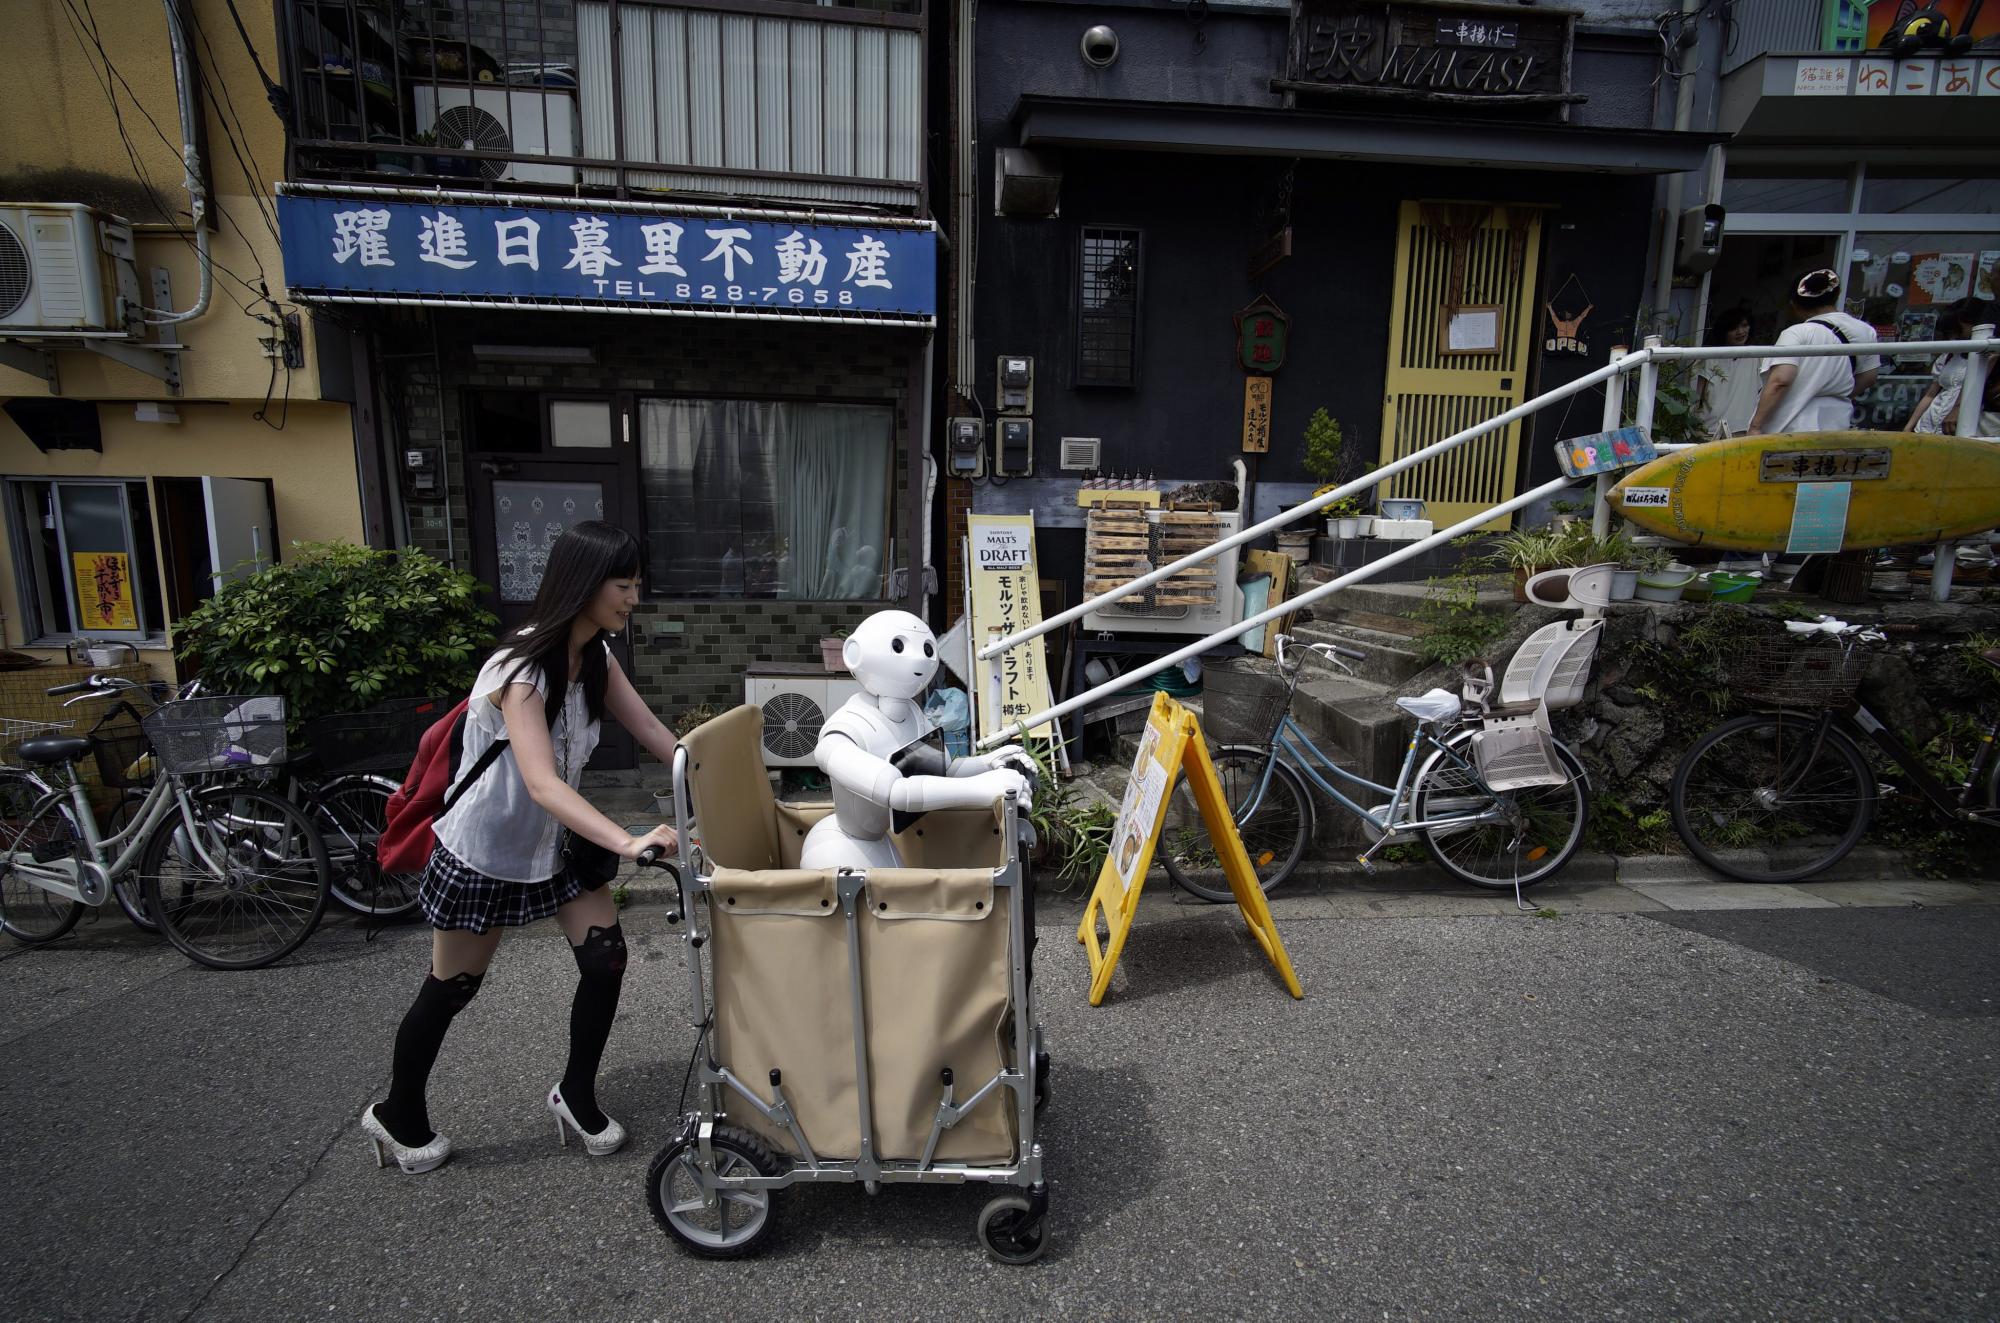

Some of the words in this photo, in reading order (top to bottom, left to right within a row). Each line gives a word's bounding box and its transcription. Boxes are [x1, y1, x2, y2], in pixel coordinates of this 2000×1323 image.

[332, 208, 893, 290] 躍進日暮里不動産
[593, 279, 656, 297] TEL
[676, 283, 854, 305] 828-7658
[1545, 337, 1589, 356] OPEN
[986, 535, 1017, 544] MALT'S
[980, 549, 1028, 562] DRAFT
[105, 556, 123, 600] ほおずき
[94, 568, 115, 615] 千成り市
